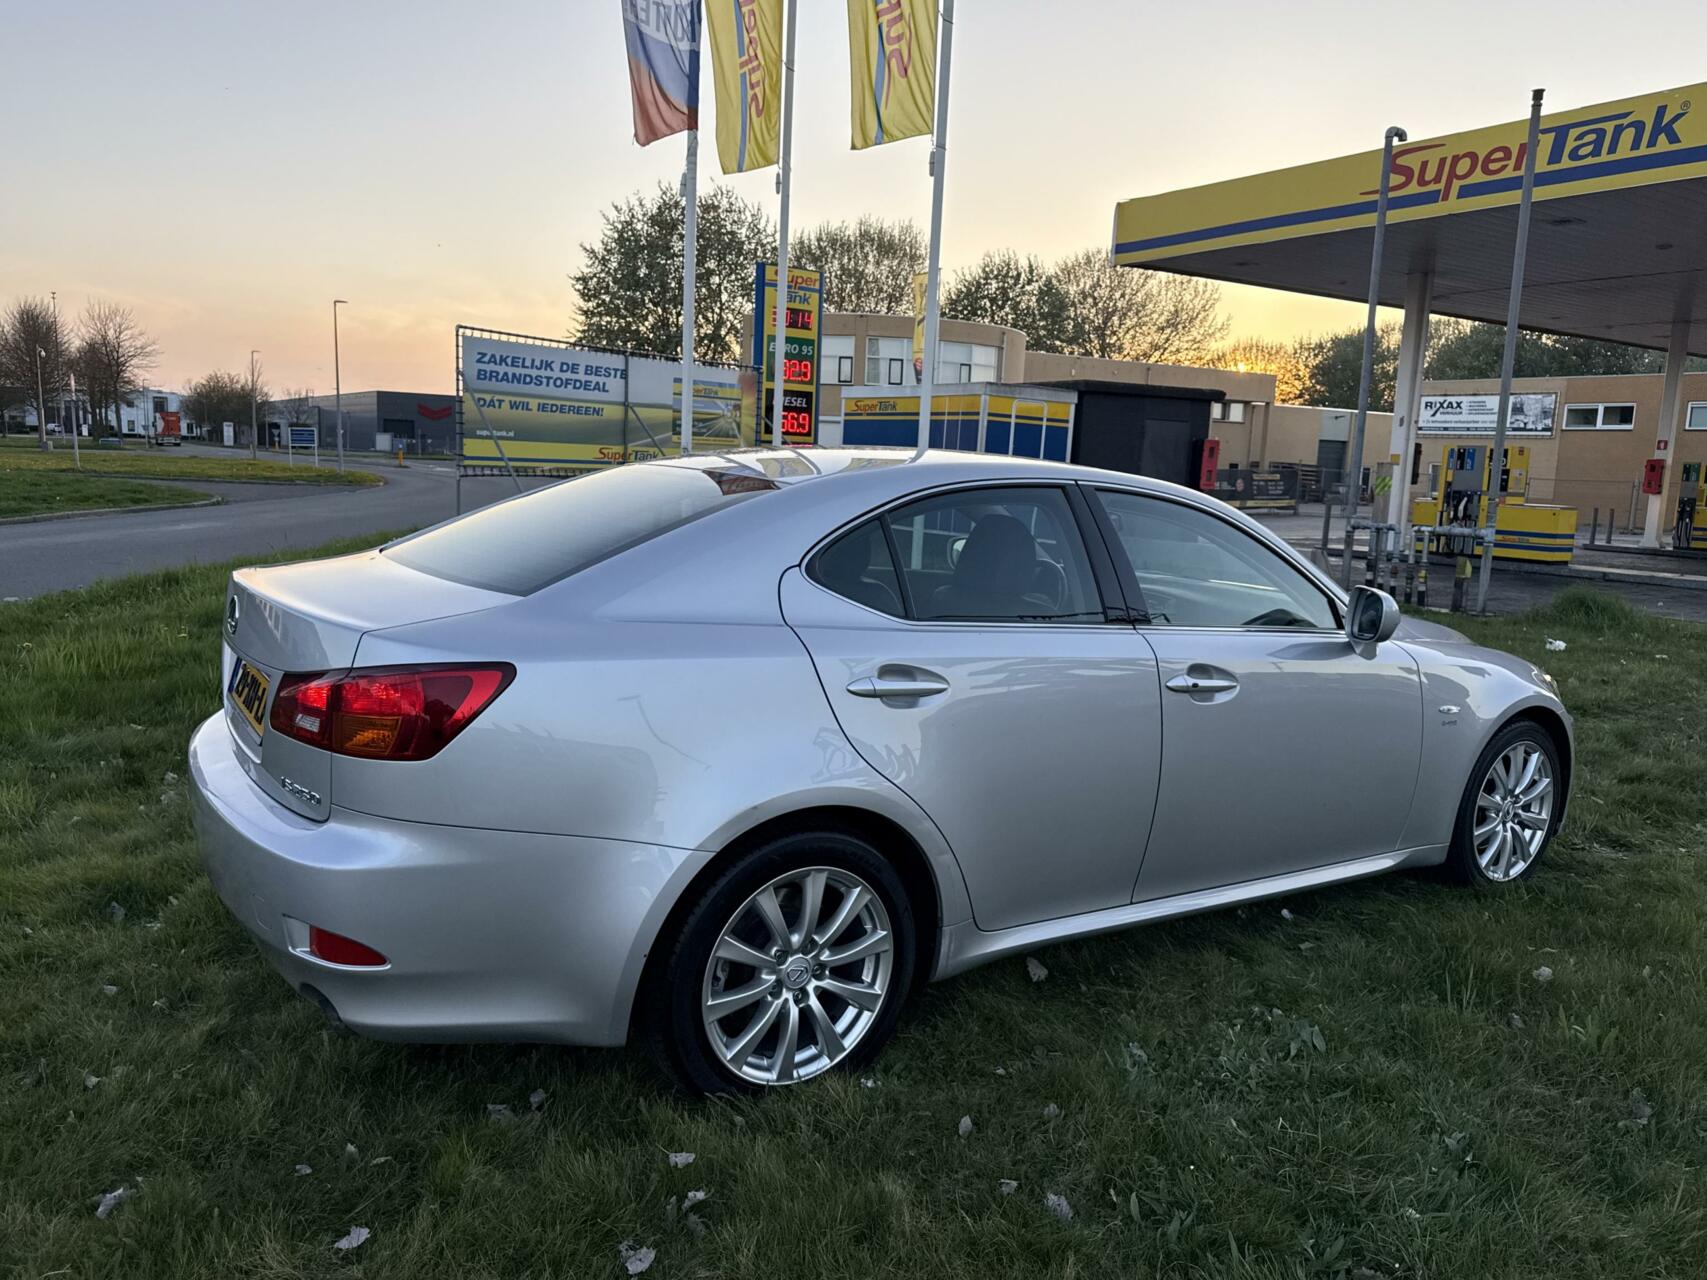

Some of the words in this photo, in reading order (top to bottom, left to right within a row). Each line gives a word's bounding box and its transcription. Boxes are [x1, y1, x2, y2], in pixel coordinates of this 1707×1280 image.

[773, 268, 819, 290] uper
[769, 341, 799, 354] ERO
[801, 344, 814, 356] 95
[476, 352, 555, 372] ZAKELIJK
[559, 361, 580, 374] DE
[584, 364, 627, 380] BESTE
[476, 368, 610, 393] BRANDSTOFDEAL
[476, 395, 505, 410] DÁT
[509, 400, 533, 412] WIL
[537, 402, 605, 417] IEDEREEN!
[773, 396, 808, 408] ESEL
